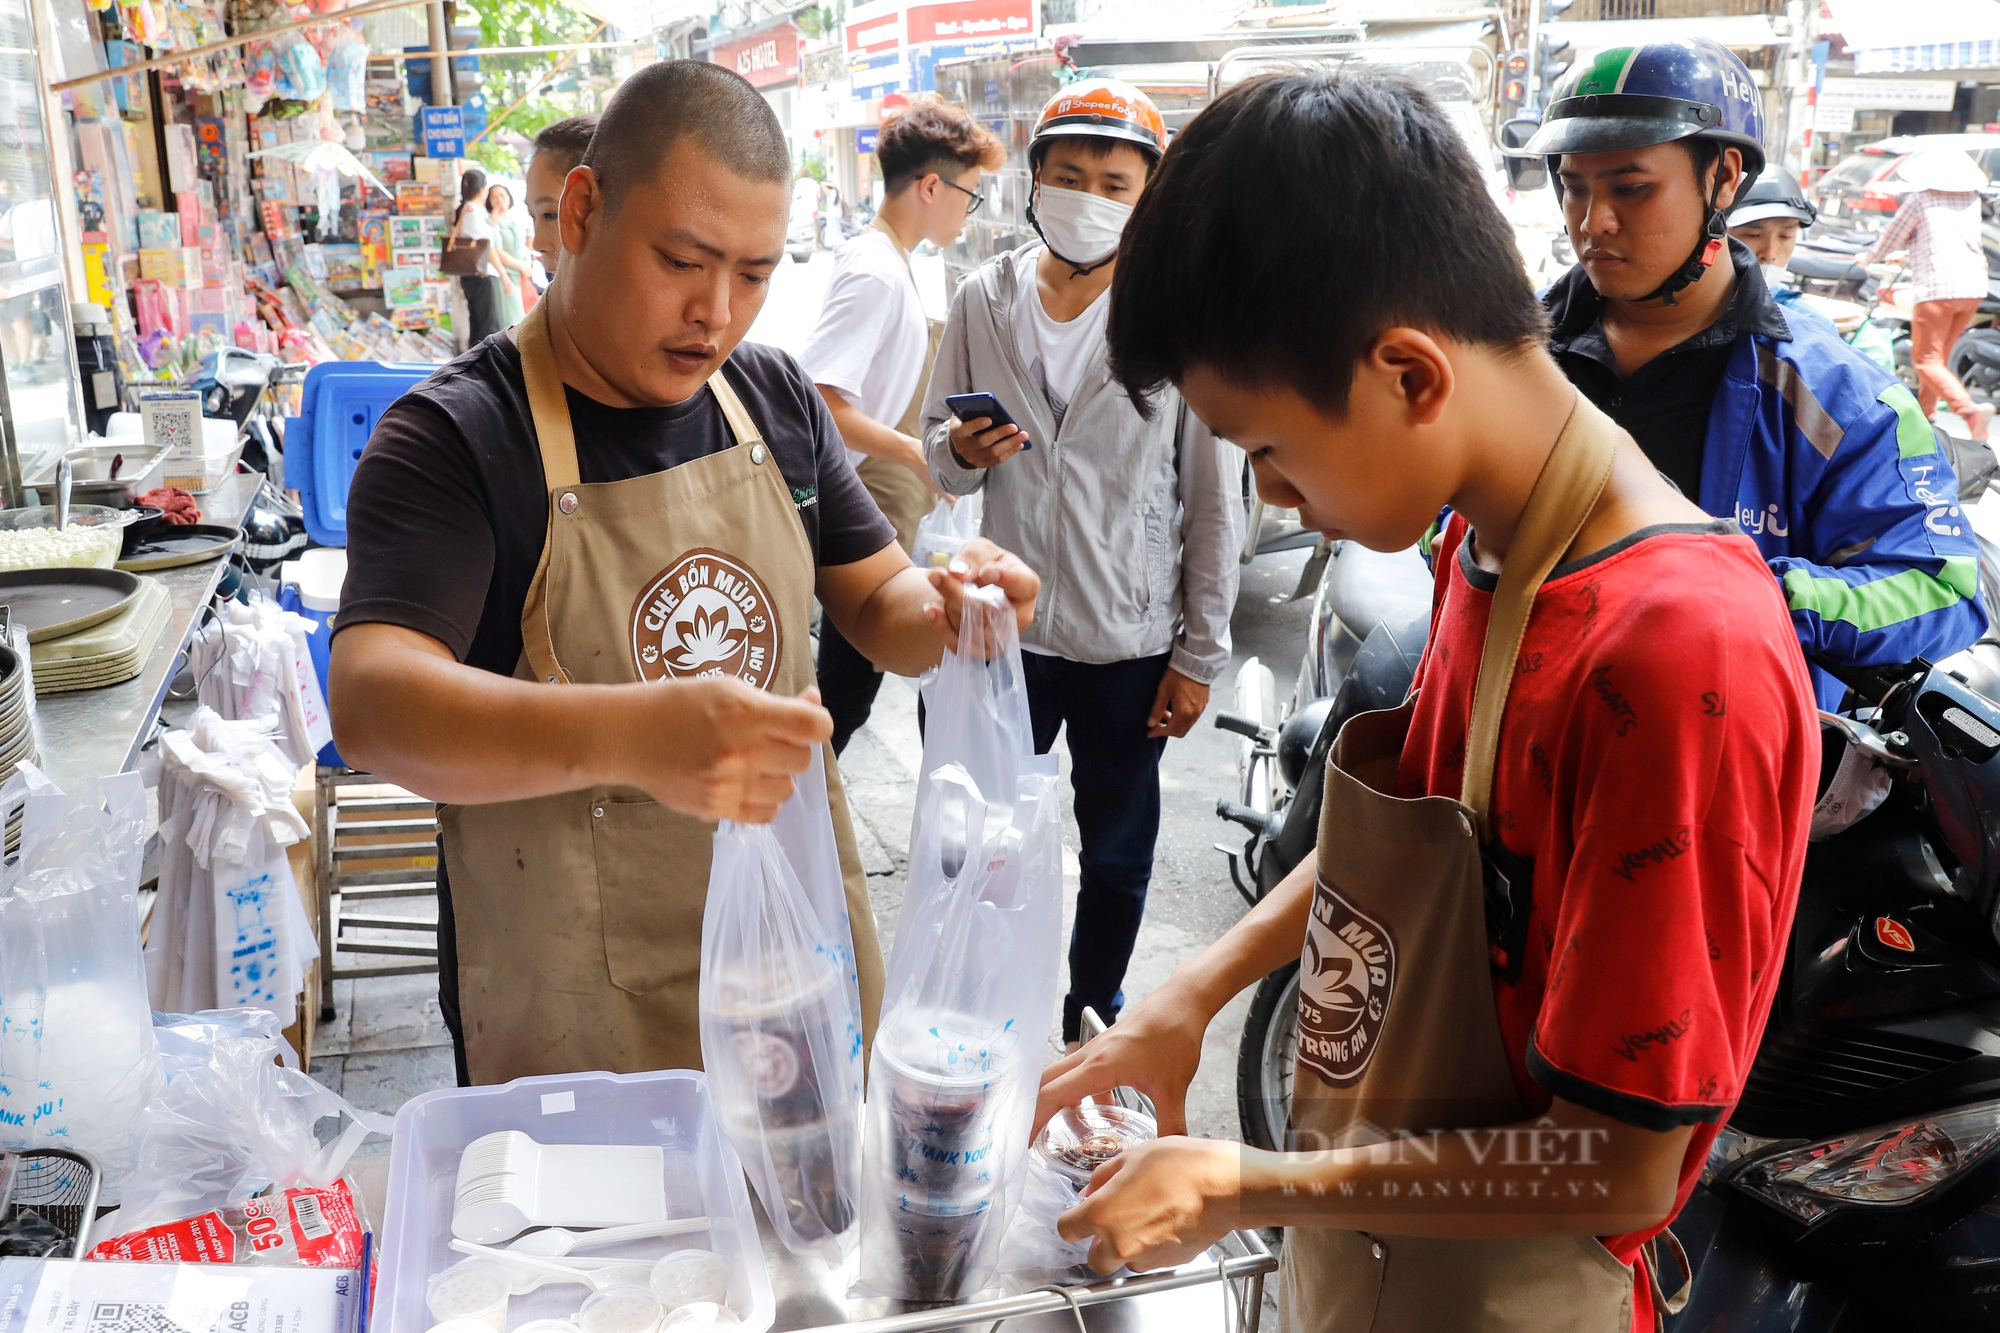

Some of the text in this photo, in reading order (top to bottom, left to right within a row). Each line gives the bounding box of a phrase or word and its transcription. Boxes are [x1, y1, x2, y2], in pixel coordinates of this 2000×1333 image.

[751, 40, 778, 72] HOTEL
[644, 560, 757, 631] CHÈ BỐN MÙA
[1338, 921, 1387, 988] MÙA
[1350, 1024, 1368, 1057] AN
[907, 1138, 960, 1165] THANK
[212, 1238, 226, 1259] HACCP
[246, 1216, 284, 1252] 50
[335, 1275, 350, 1297] ACB
[228, 1300, 250, 1333] ACB
